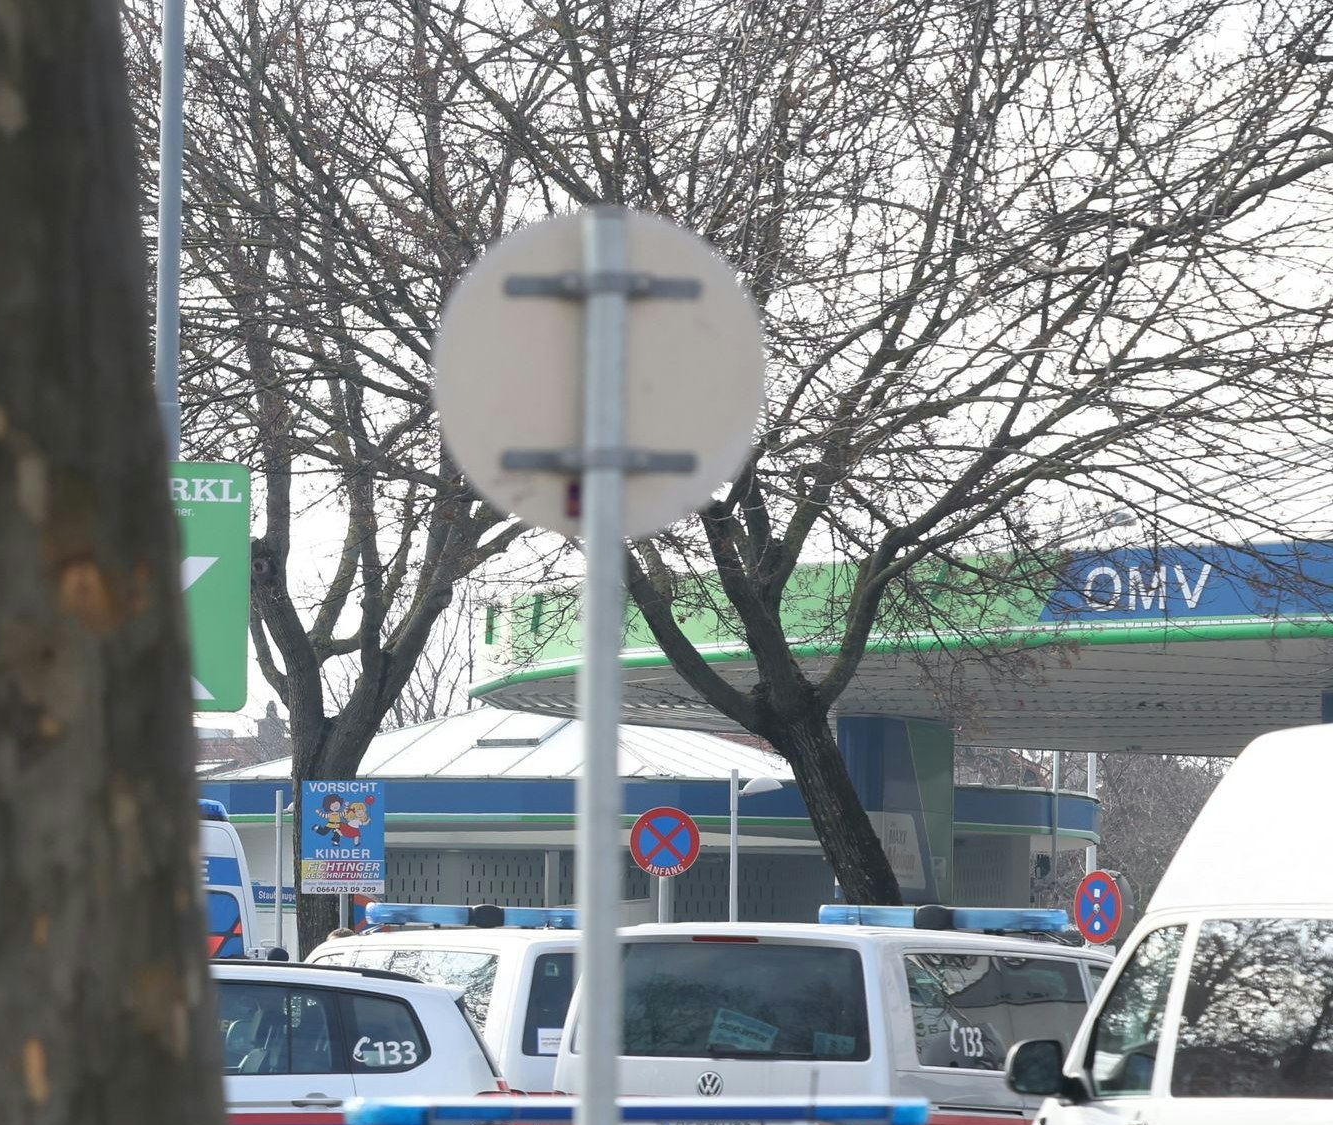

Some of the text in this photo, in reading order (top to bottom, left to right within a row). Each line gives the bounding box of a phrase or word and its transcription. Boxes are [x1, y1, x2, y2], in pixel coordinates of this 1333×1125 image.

[169, 477, 242, 503] RKL
[1084, 563, 1213, 612] OMV
[308, 782, 378, 793] VORSICHT
[315, 848, 371, 859] KINDER
[646, 863, 684, 876] ANFANG
[373, 1040, 418, 1065] 133
[959, 1026, 984, 1057] 133
